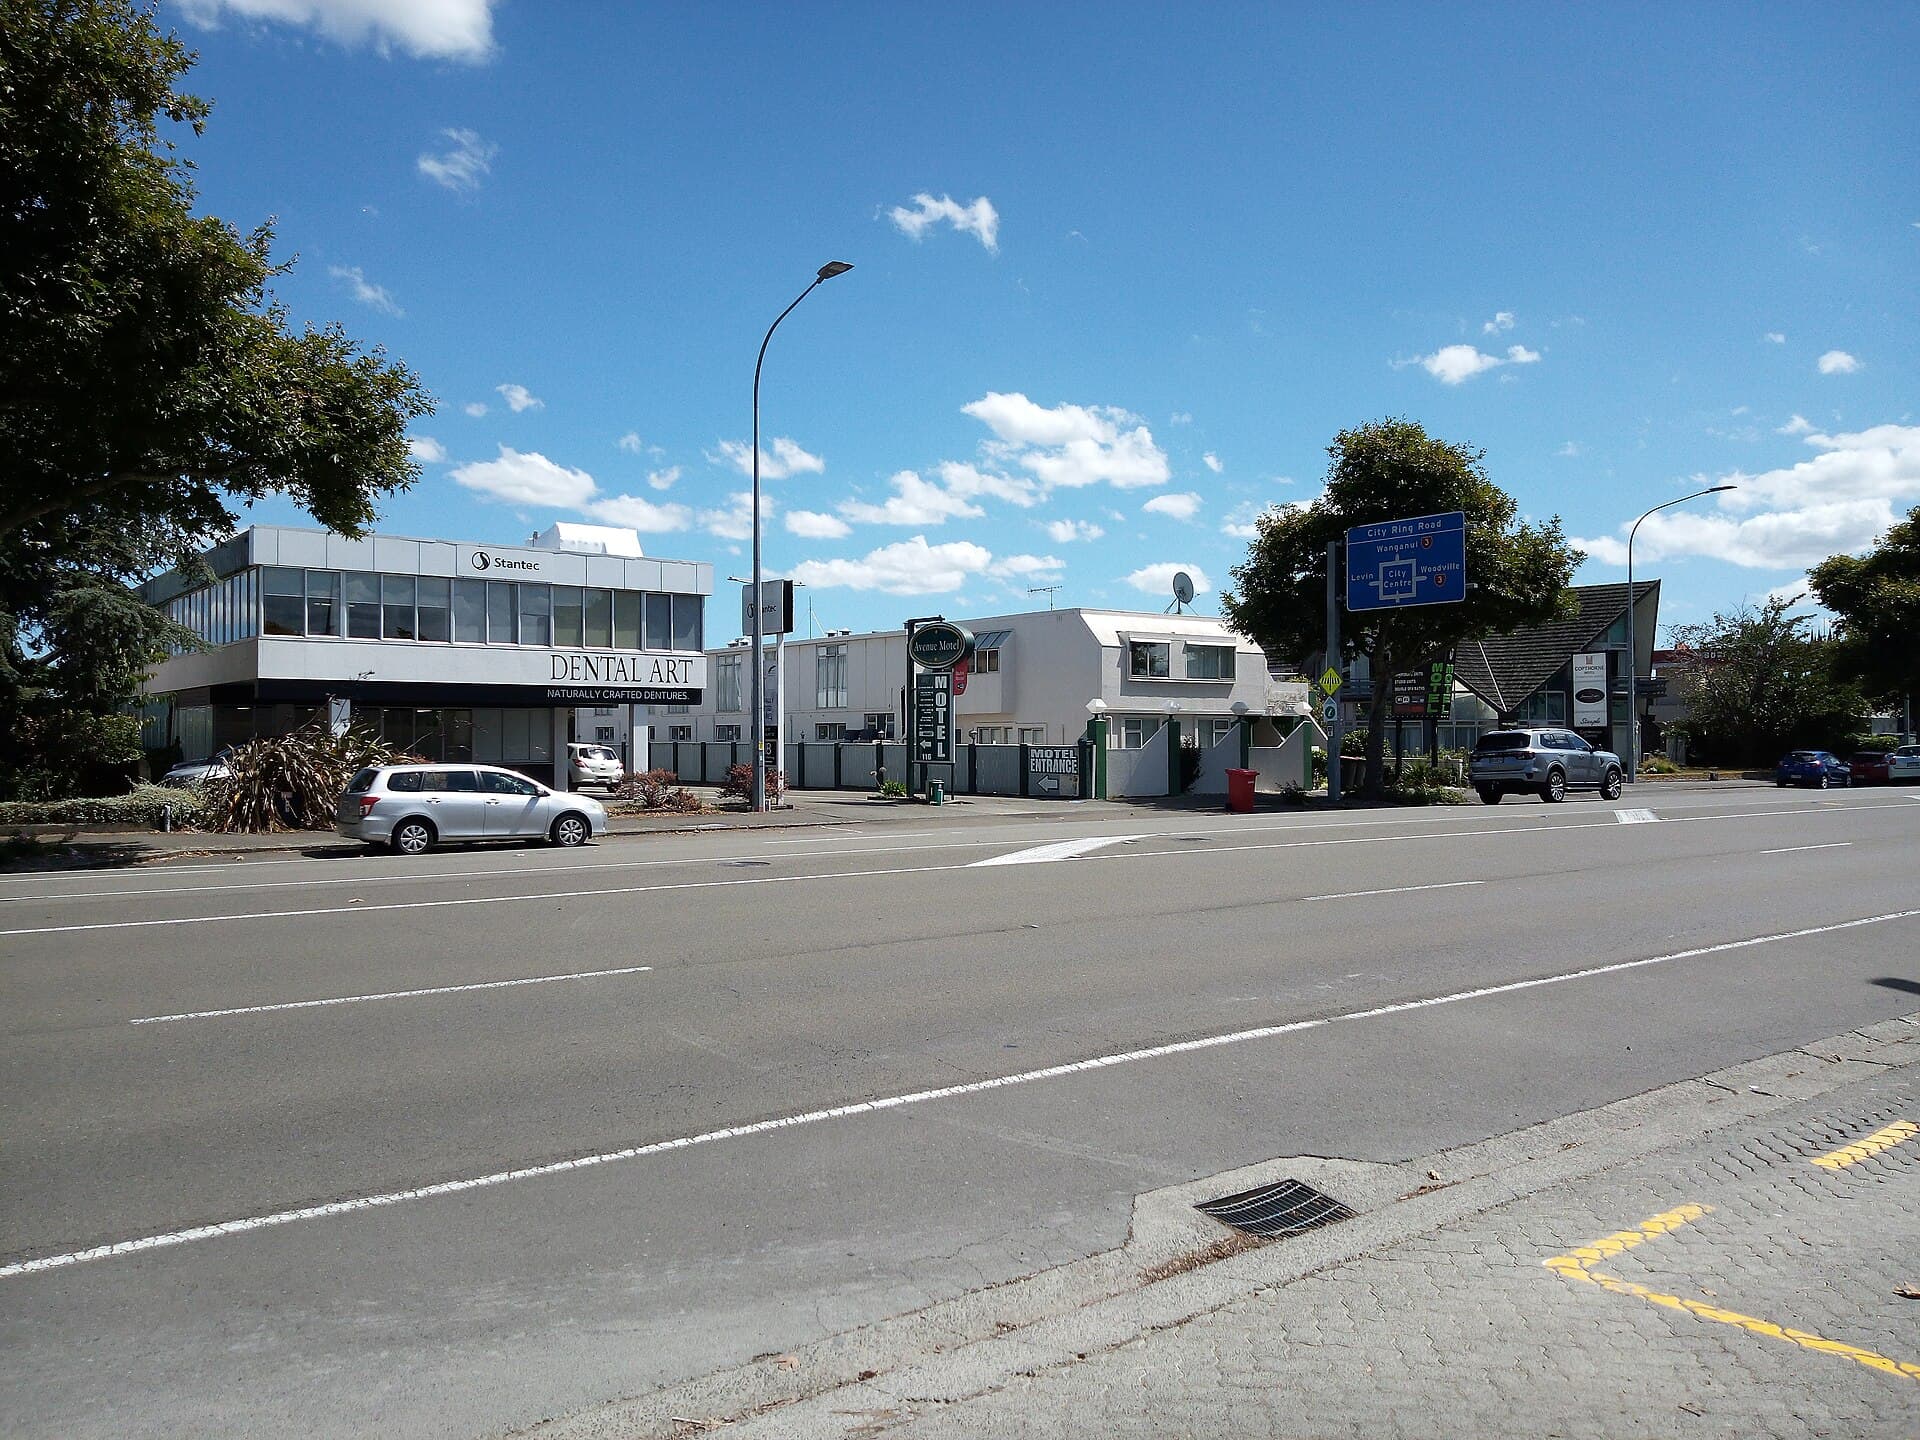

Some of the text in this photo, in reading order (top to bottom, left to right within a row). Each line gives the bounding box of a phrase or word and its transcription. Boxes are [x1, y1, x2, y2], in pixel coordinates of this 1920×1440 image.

[1367, 520, 1442, 537] City Ring Road
[1376, 541, 1418, 553] Wanganui
[494, 557, 540, 571] Stantec
[1420, 562, 1460, 573] Woodville
[1351, 572, 1374, 581] Levin
[1388, 570, 1407, 578] City
[1383, 580, 1412, 588] Centre
[914, 638, 960, 652] Avenue Motel
[550, 655, 693, 684] DENTAL ART
[1427, 662, 1444, 713] MOTEL
[547, 689, 690, 700] NATURALLY CRAFTED DENTURES.
[935, 675, 947, 758] MOTEL
[1030, 749, 1077, 759] MOTEL
[1030, 759, 1078, 774] ENTRANCE
